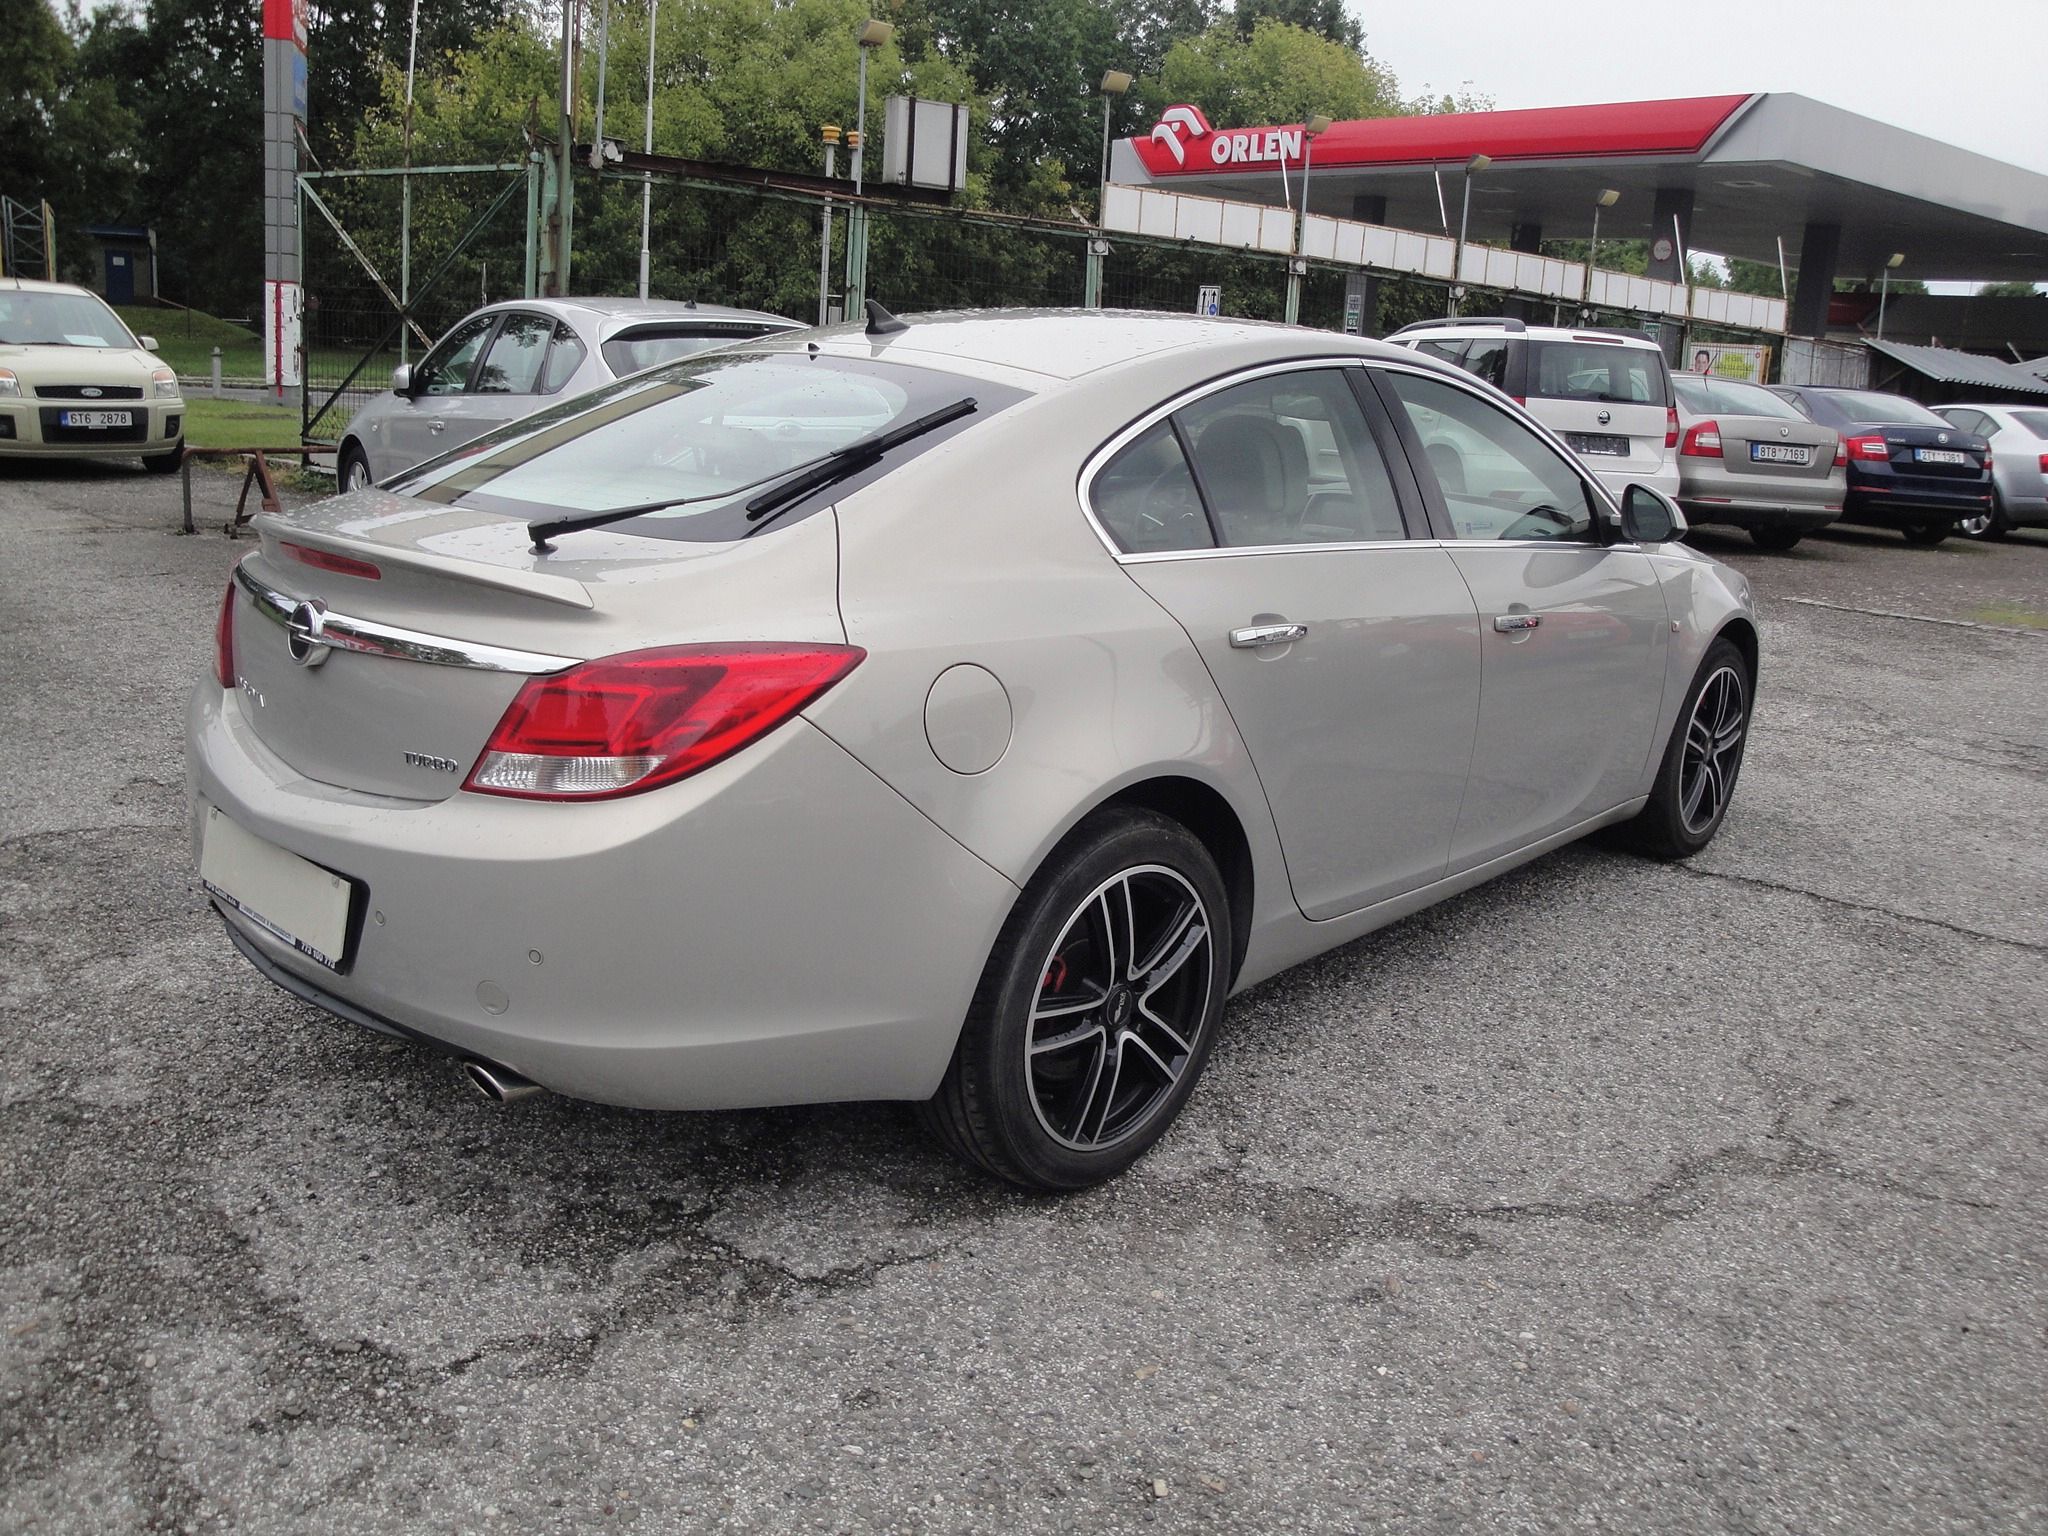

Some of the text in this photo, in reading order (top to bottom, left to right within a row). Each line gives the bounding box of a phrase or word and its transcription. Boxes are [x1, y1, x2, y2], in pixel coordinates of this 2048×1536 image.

[1211, 131, 1302, 164] ORLEN
[70, 413, 127, 425] 6T6 2878
[1760, 446, 1805, 460] 8T8 7169
[403, 750, 458, 773] TURBO
